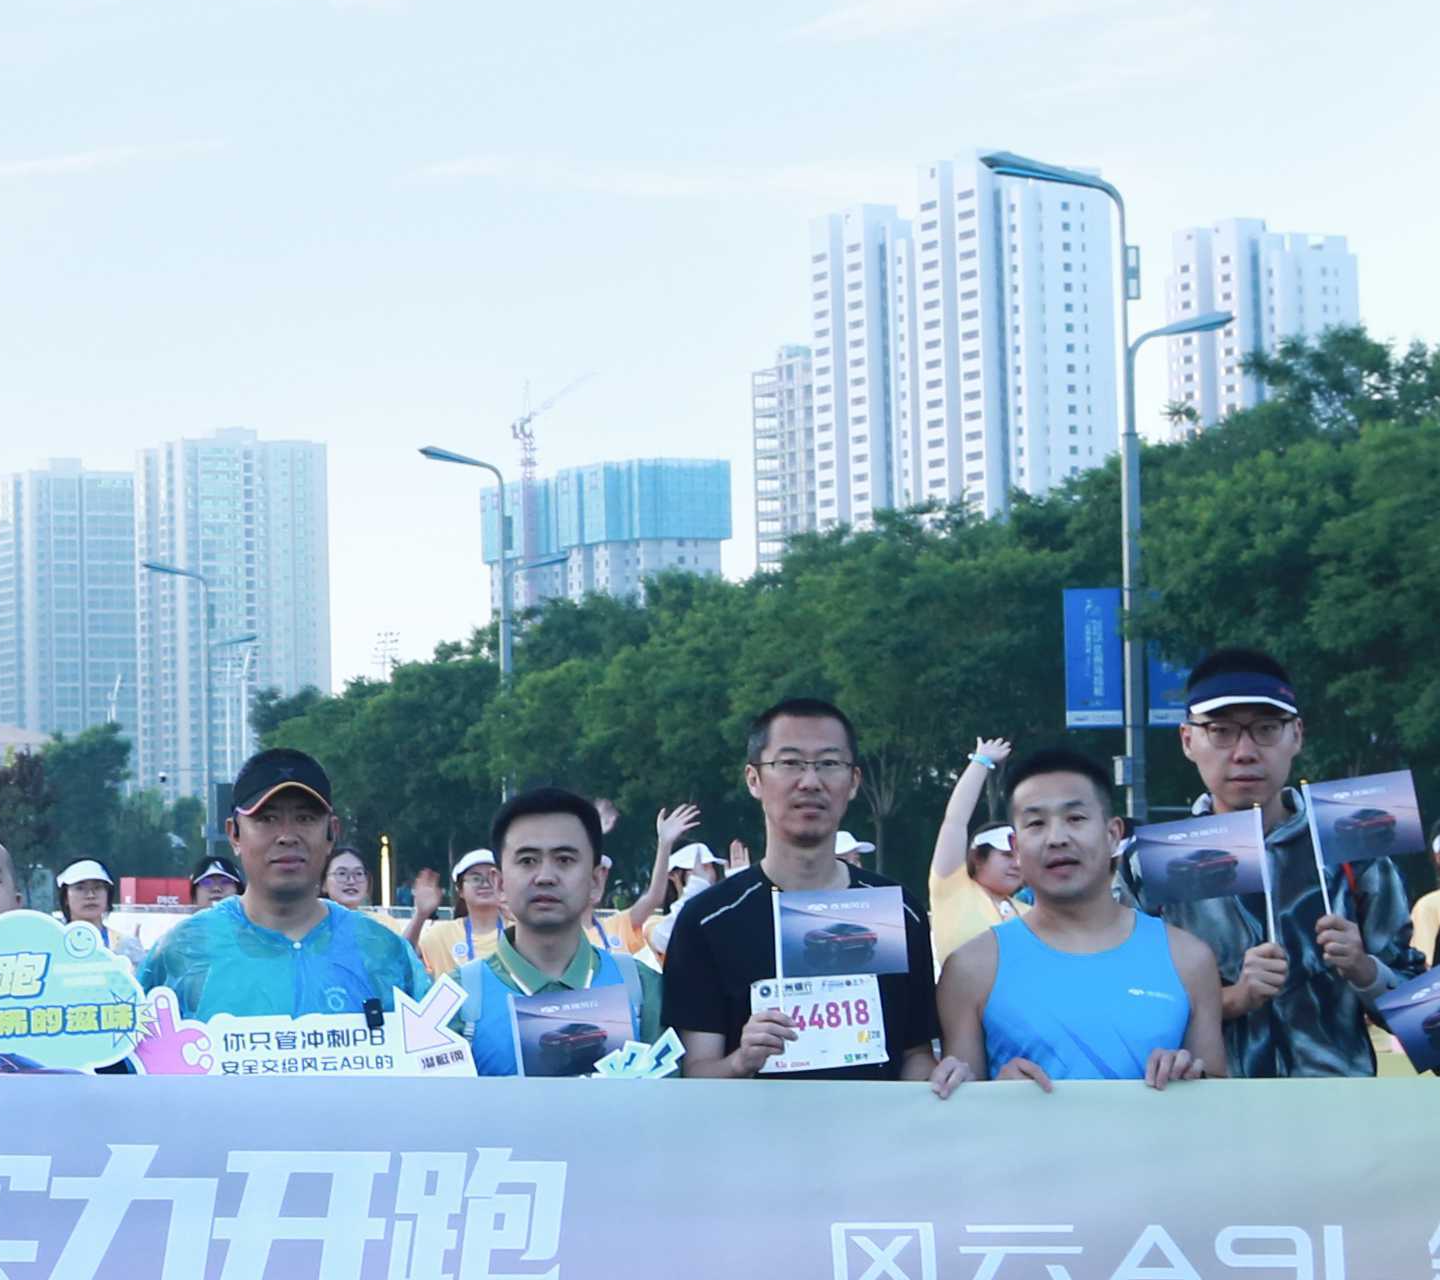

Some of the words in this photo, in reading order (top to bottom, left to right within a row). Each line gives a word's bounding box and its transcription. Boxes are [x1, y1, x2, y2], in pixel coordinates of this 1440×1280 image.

[768, 998, 870, 1032] 44818
[222, 1028, 386, 1053] 你只管冲刺PB
[221, 1055, 395, 1076] 安全交给风云A9L的
